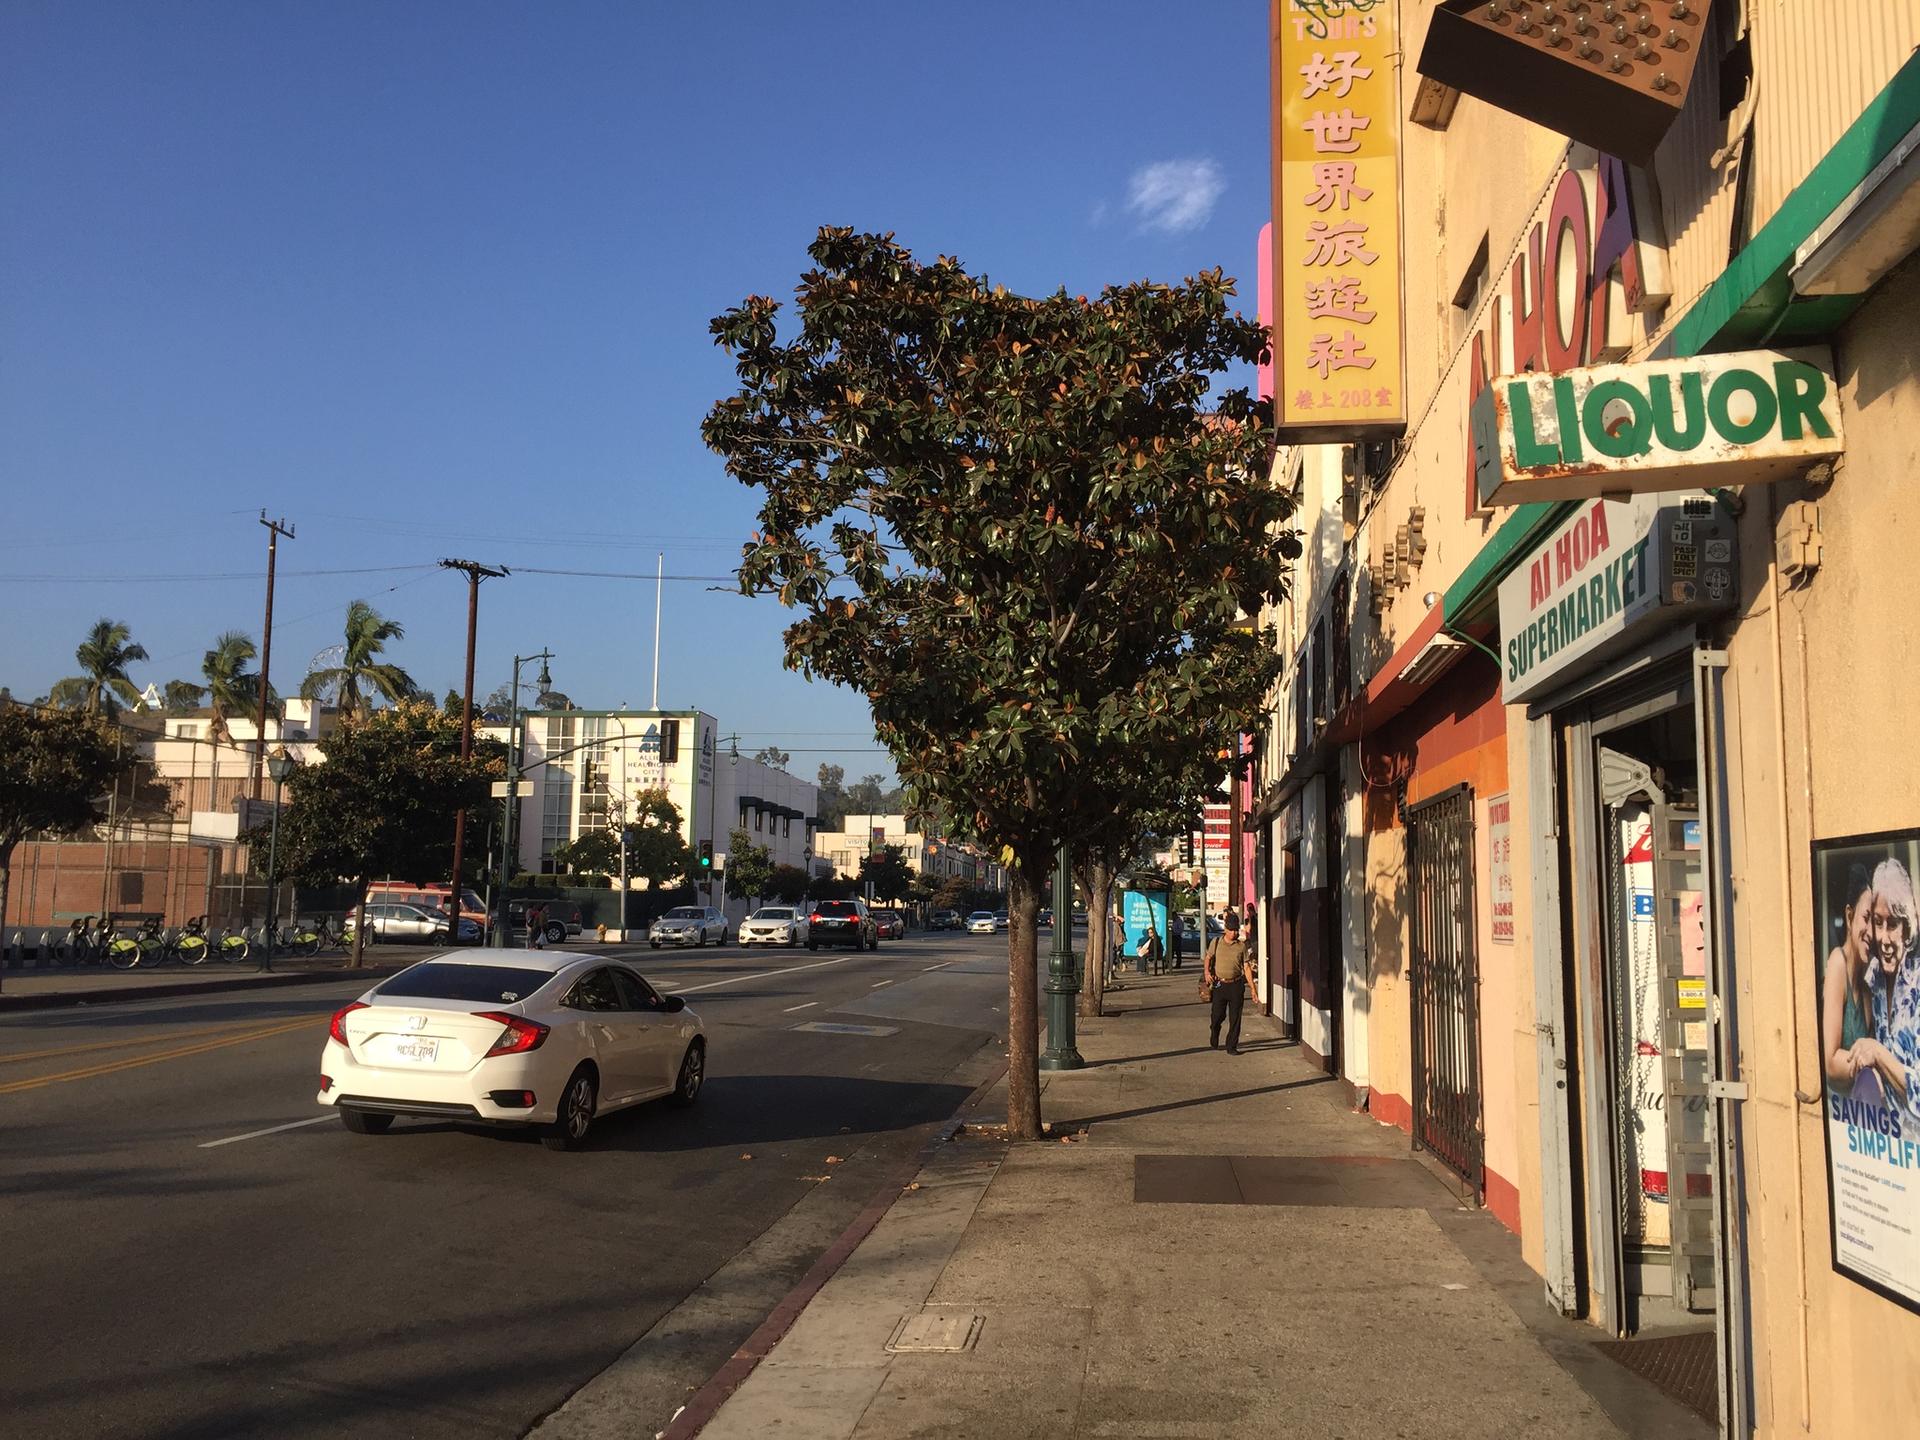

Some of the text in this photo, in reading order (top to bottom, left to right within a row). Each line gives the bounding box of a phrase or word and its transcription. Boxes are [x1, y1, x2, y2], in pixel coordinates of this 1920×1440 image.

[1299, 51, 1380, 380] 好世界旅遊社
[1507, 360, 1835, 468] LIQUOR
[1507, 535, 1649, 684] SUPERMARKET
[1530, 501, 1610, 612] AI HOA
[1831, 1094, 1902, 1140] SAVINGS
